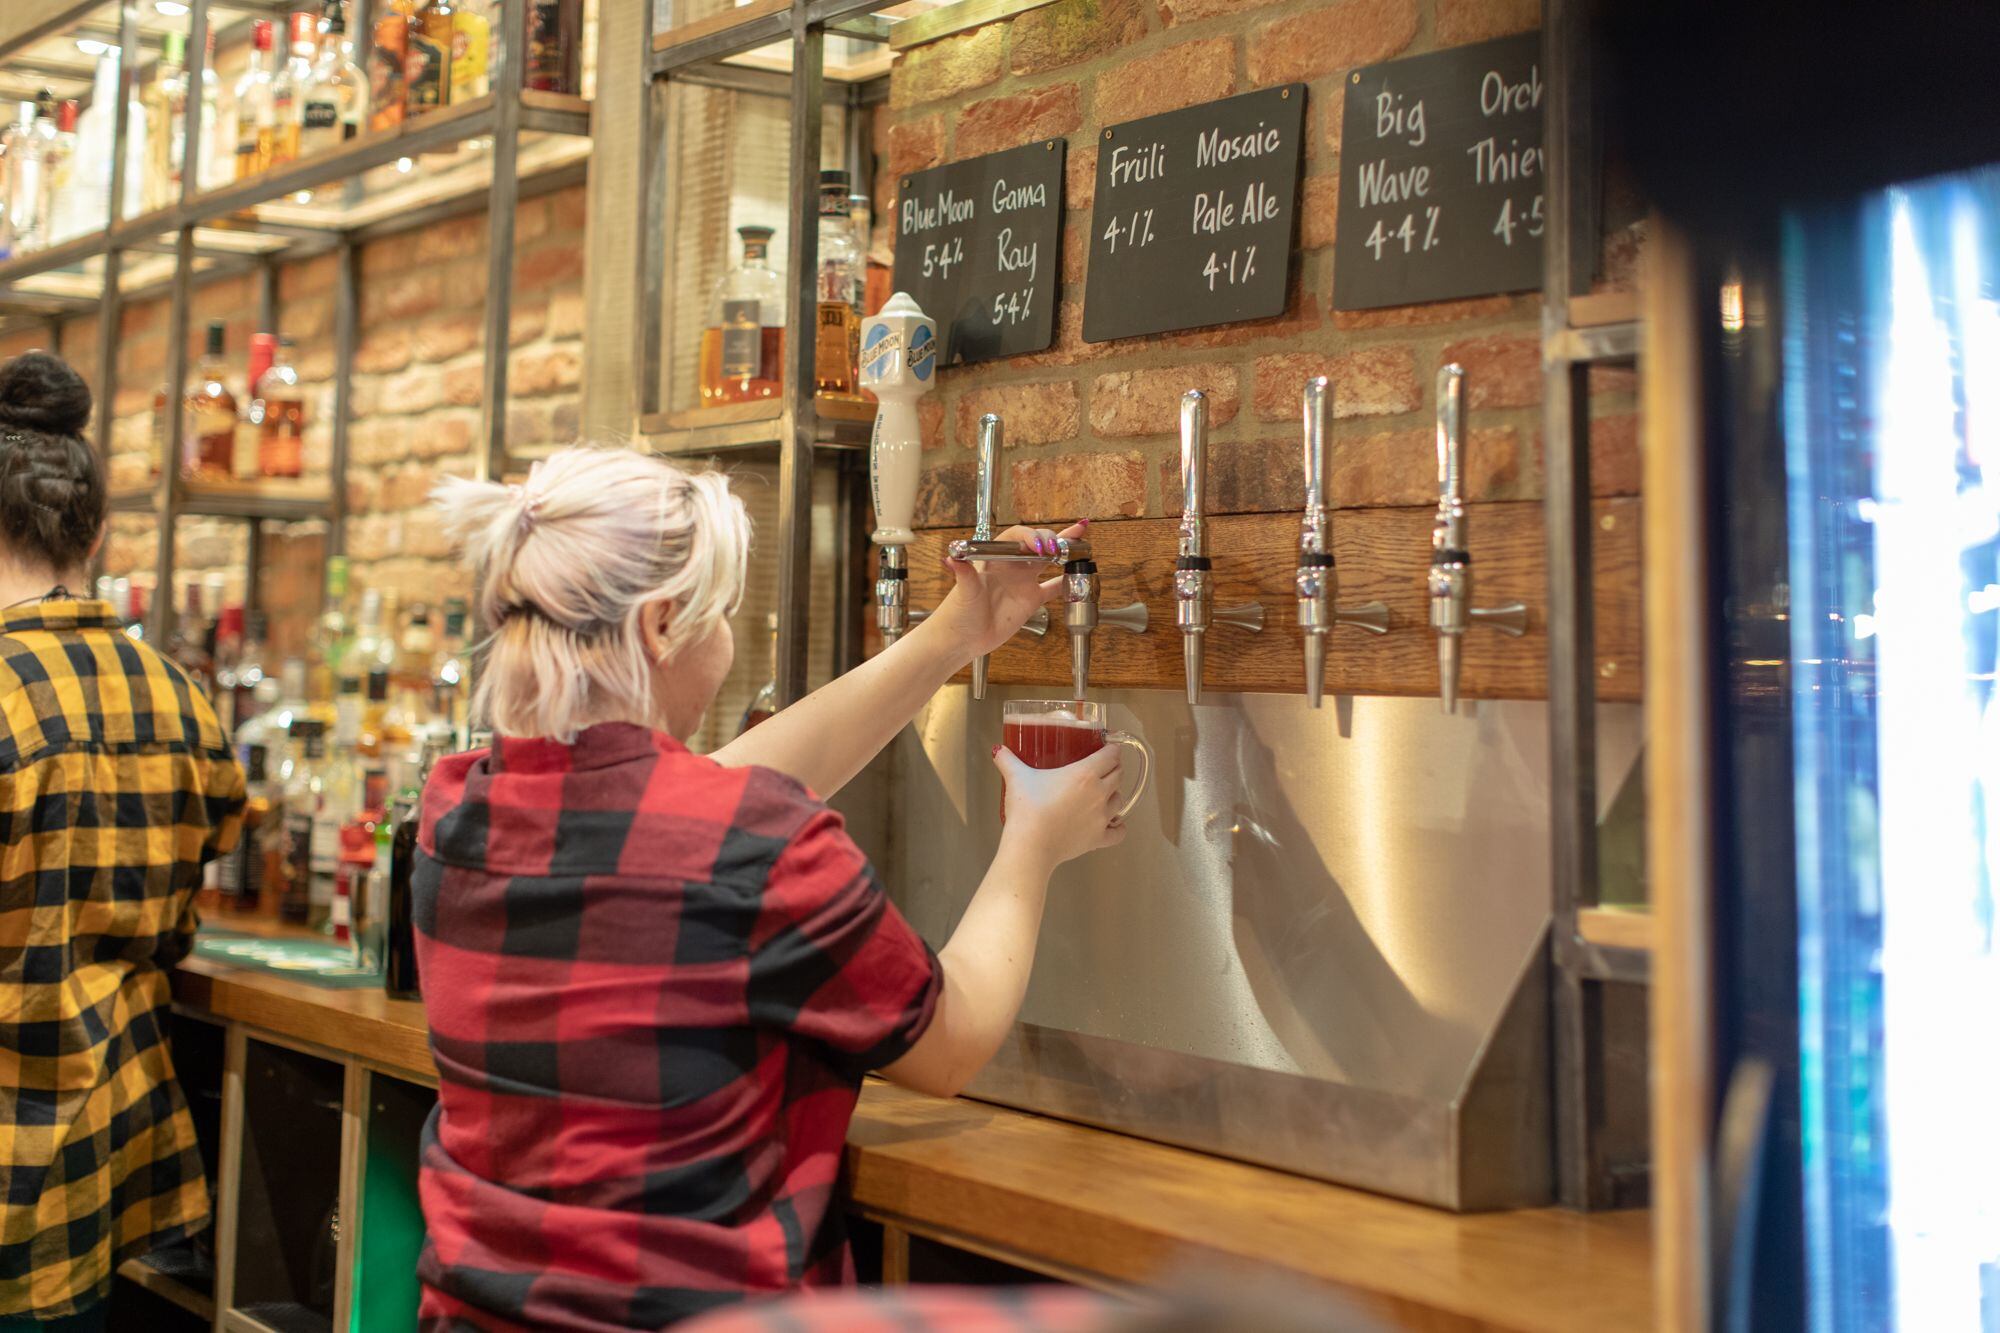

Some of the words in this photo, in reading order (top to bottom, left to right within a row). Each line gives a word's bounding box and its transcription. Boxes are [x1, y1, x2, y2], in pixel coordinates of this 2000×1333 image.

[1376, 91, 1426, 147] Big
[1110, 142, 1166, 188] Früli
[1196, 121, 1280, 169] Mosaic
[992, 178, 1046, 214] Gama
[1192, 190, 1235, 235] Pale
[1240, 181, 1280, 225] Ale
[1359, 158, 1430, 209] Wave
[902, 197, 937, 236] Blue
[937, 189, 975, 227] Moon
[997, 227, 1038, 283] Ray
